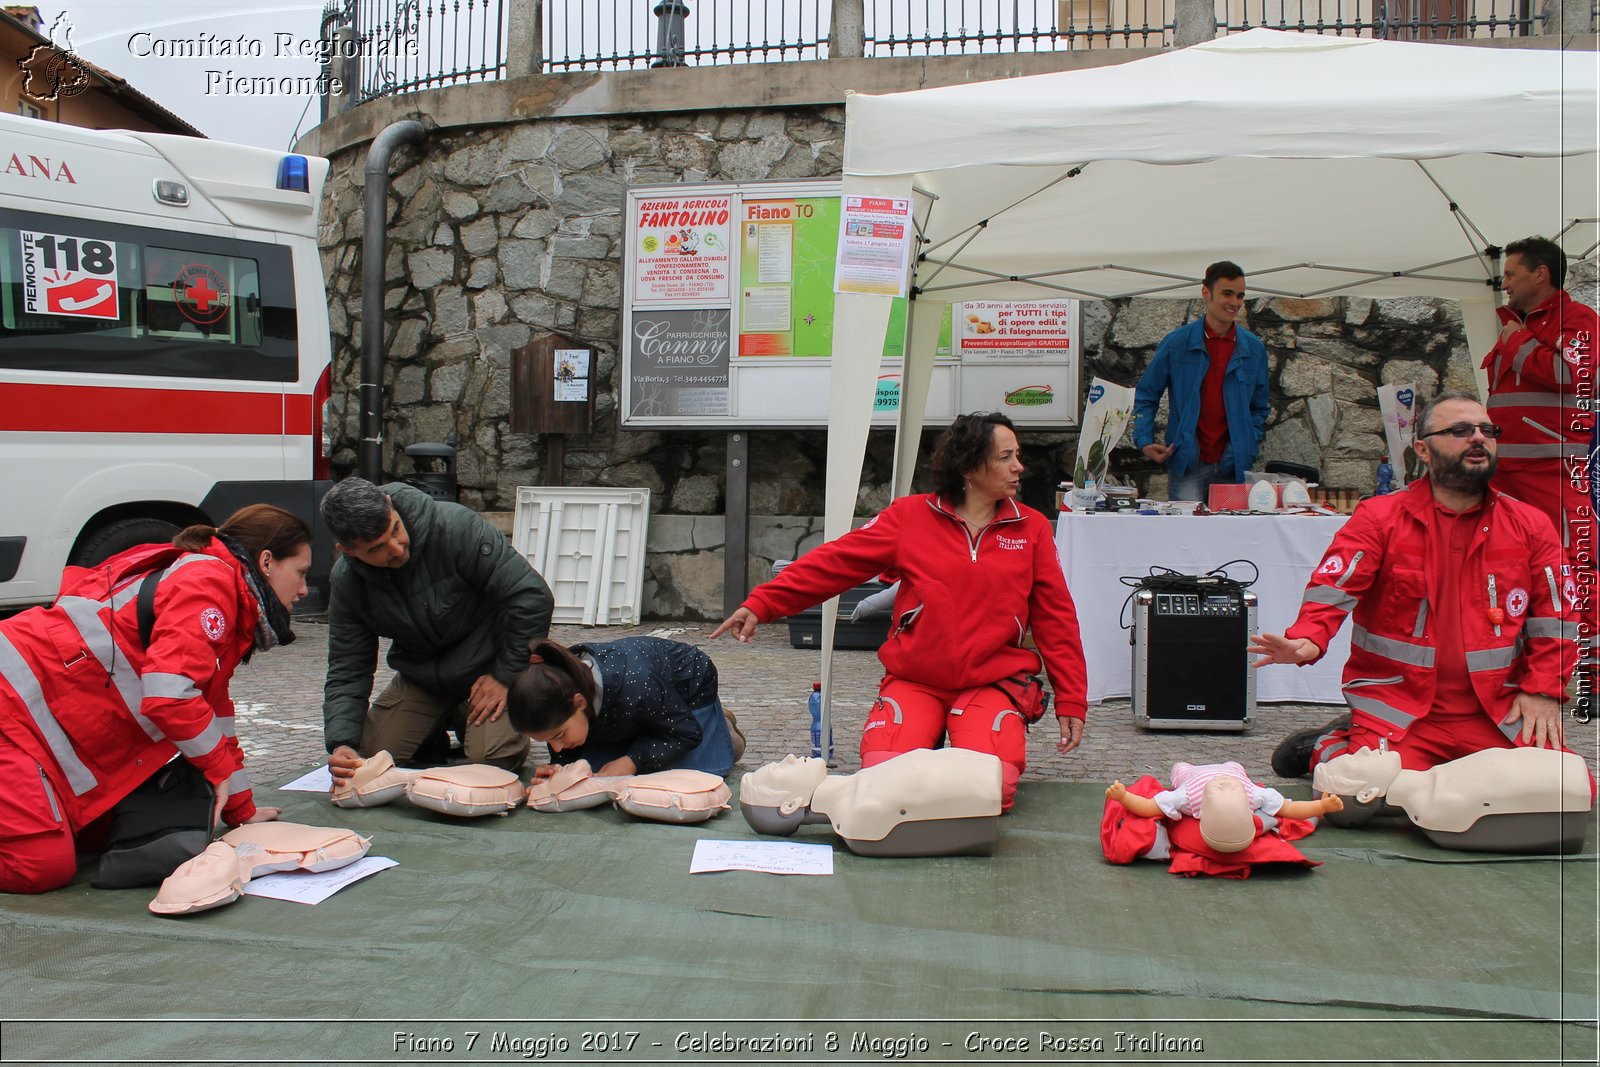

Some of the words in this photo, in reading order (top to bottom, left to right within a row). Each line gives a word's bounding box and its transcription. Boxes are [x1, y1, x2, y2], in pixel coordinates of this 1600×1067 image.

[0, 152, 77, 185] ANA
[640, 200, 679, 211] AZIENDA
[682, 199, 728, 209] AGRICOLA
[747, 204, 791, 219] Fiano
[795, 203, 814, 218] TO
[639, 209, 729, 228] FANTOLINO
[34, 234, 116, 276] 118
[22, 232, 38, 313] PIEMONTE
[1016, 309, 1042, 317] TUTTI
[1051, 309, 1067, 318] tipi
[998, 318, 1007, 326] di
[1010, 320, 1036, 328] opere
[1038, 318, 1058, 326] edili
[666, 331, 728, 339] PARRUCCHIERA
[998, 327, 1007, 335] di
[1009, 327, 1067, 336] falegnameria
[634, 319, 728, 365] Conny
[657, 356, 664, 364] A
[665, 355, 694, 364] FIANO
[996, 534, 1010, 544] CROCE
[998, 541, 1024, 550] ITALIANA
